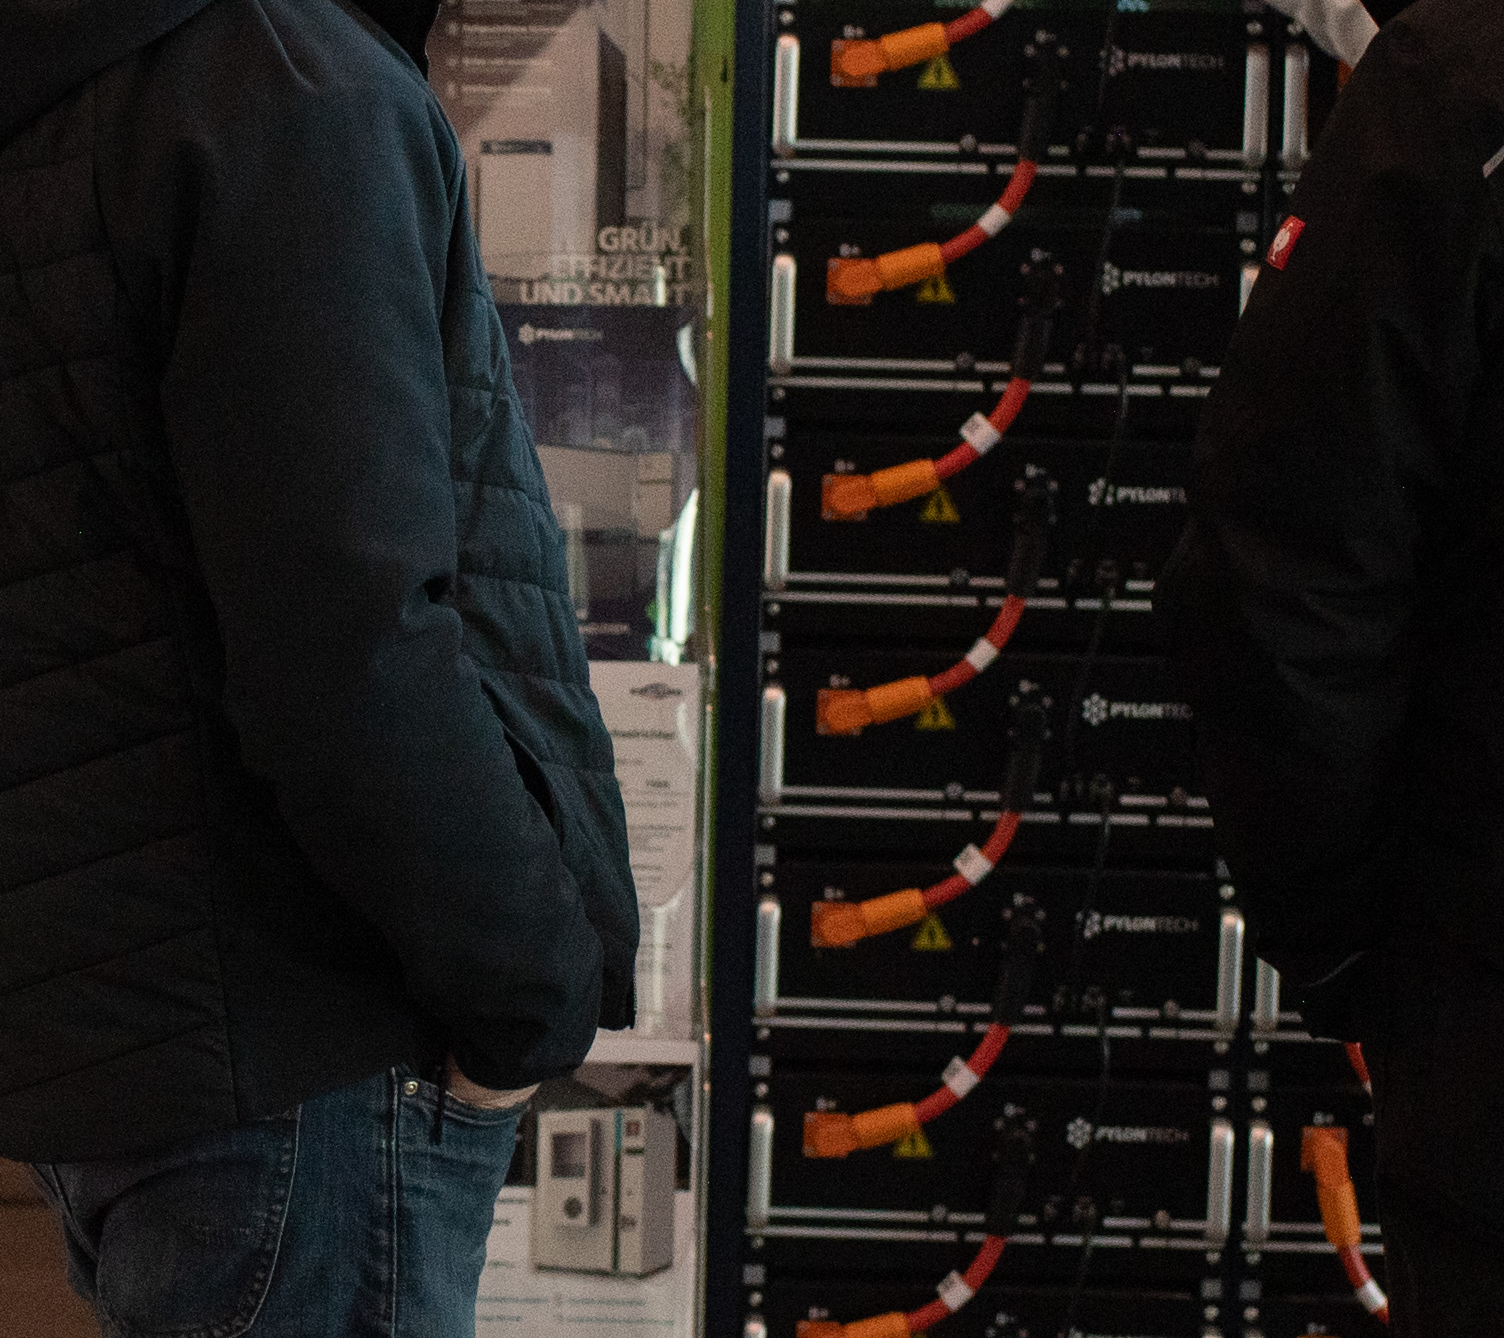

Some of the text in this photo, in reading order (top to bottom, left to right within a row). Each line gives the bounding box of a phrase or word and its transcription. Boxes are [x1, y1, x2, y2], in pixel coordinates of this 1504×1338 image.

[1126, 50, 1225, 69] PYLONTECH
[598, 221, 687, 254] GRÜN,
[1122, 269, 1221, 288] PYLONTECH
[519, 283, 584, 305] UND
[1103, 913, 1199, 932] PYLONTECH
